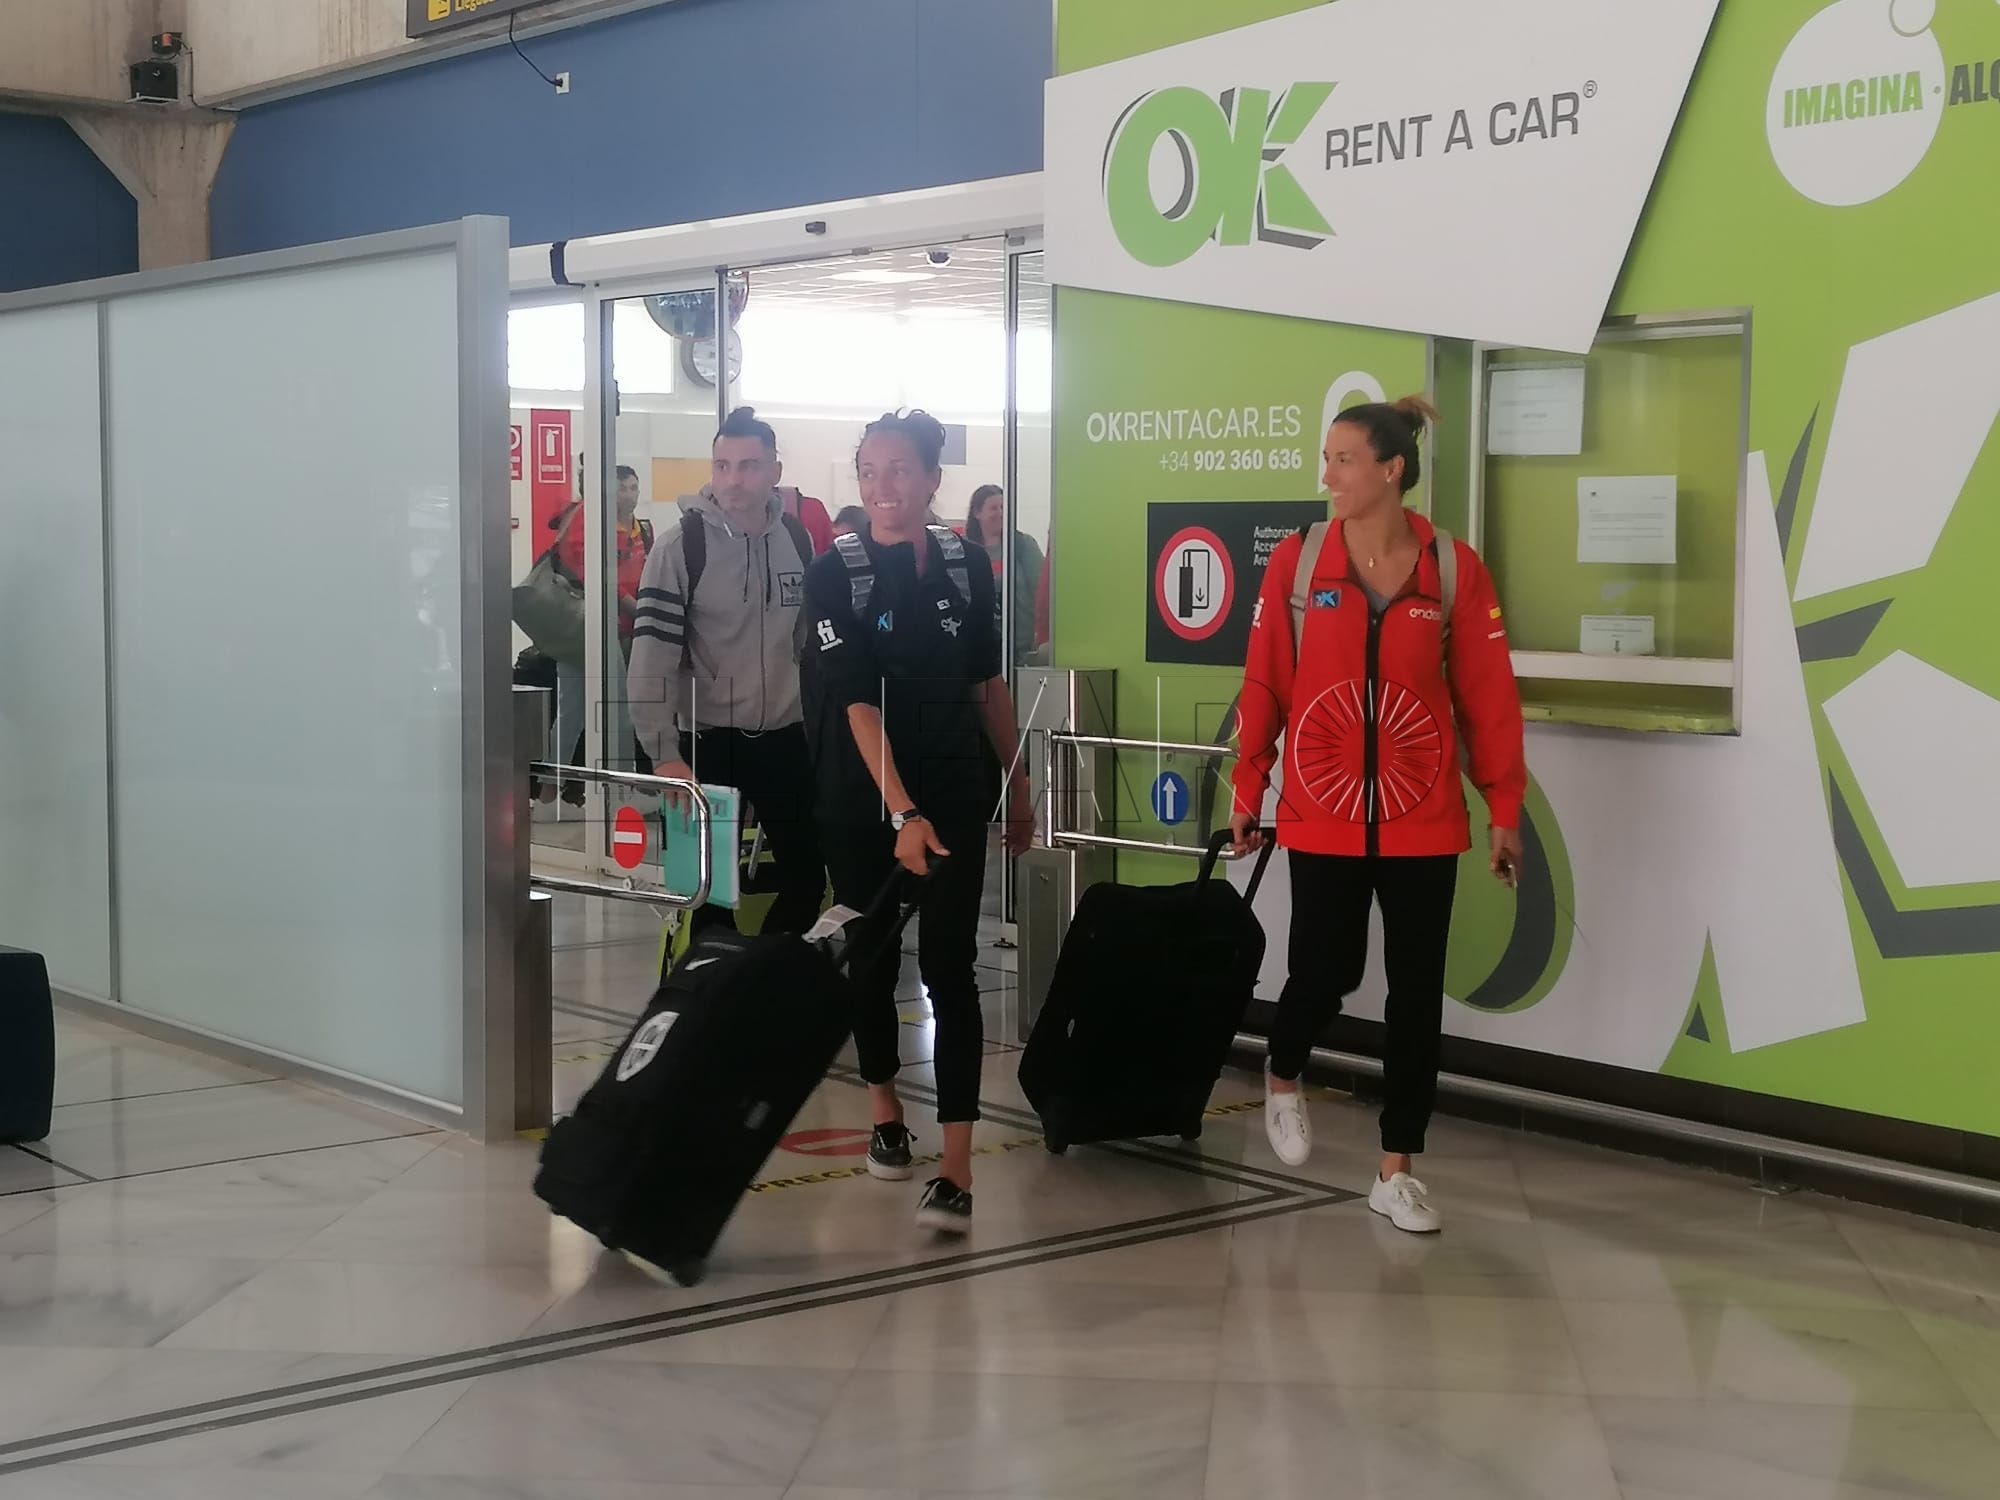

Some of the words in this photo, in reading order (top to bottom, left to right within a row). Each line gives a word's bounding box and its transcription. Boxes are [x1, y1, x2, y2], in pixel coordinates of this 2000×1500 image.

[1783, 70, 1924, 128] IMAGINA
[1102, 81, 1338, 267] OK
[1325, 114, 1432, 170] RENT
[1444, 109, 1473, 153] A
[1086, 405, 1301, 443] OKRENTACAR.ES
[1159, 451, 1189, 472] +34
[1193, 449, 1226, 471] 902
[1230, 448, 1264, 470] 360
[1268, 447, 1303, 470] 636
